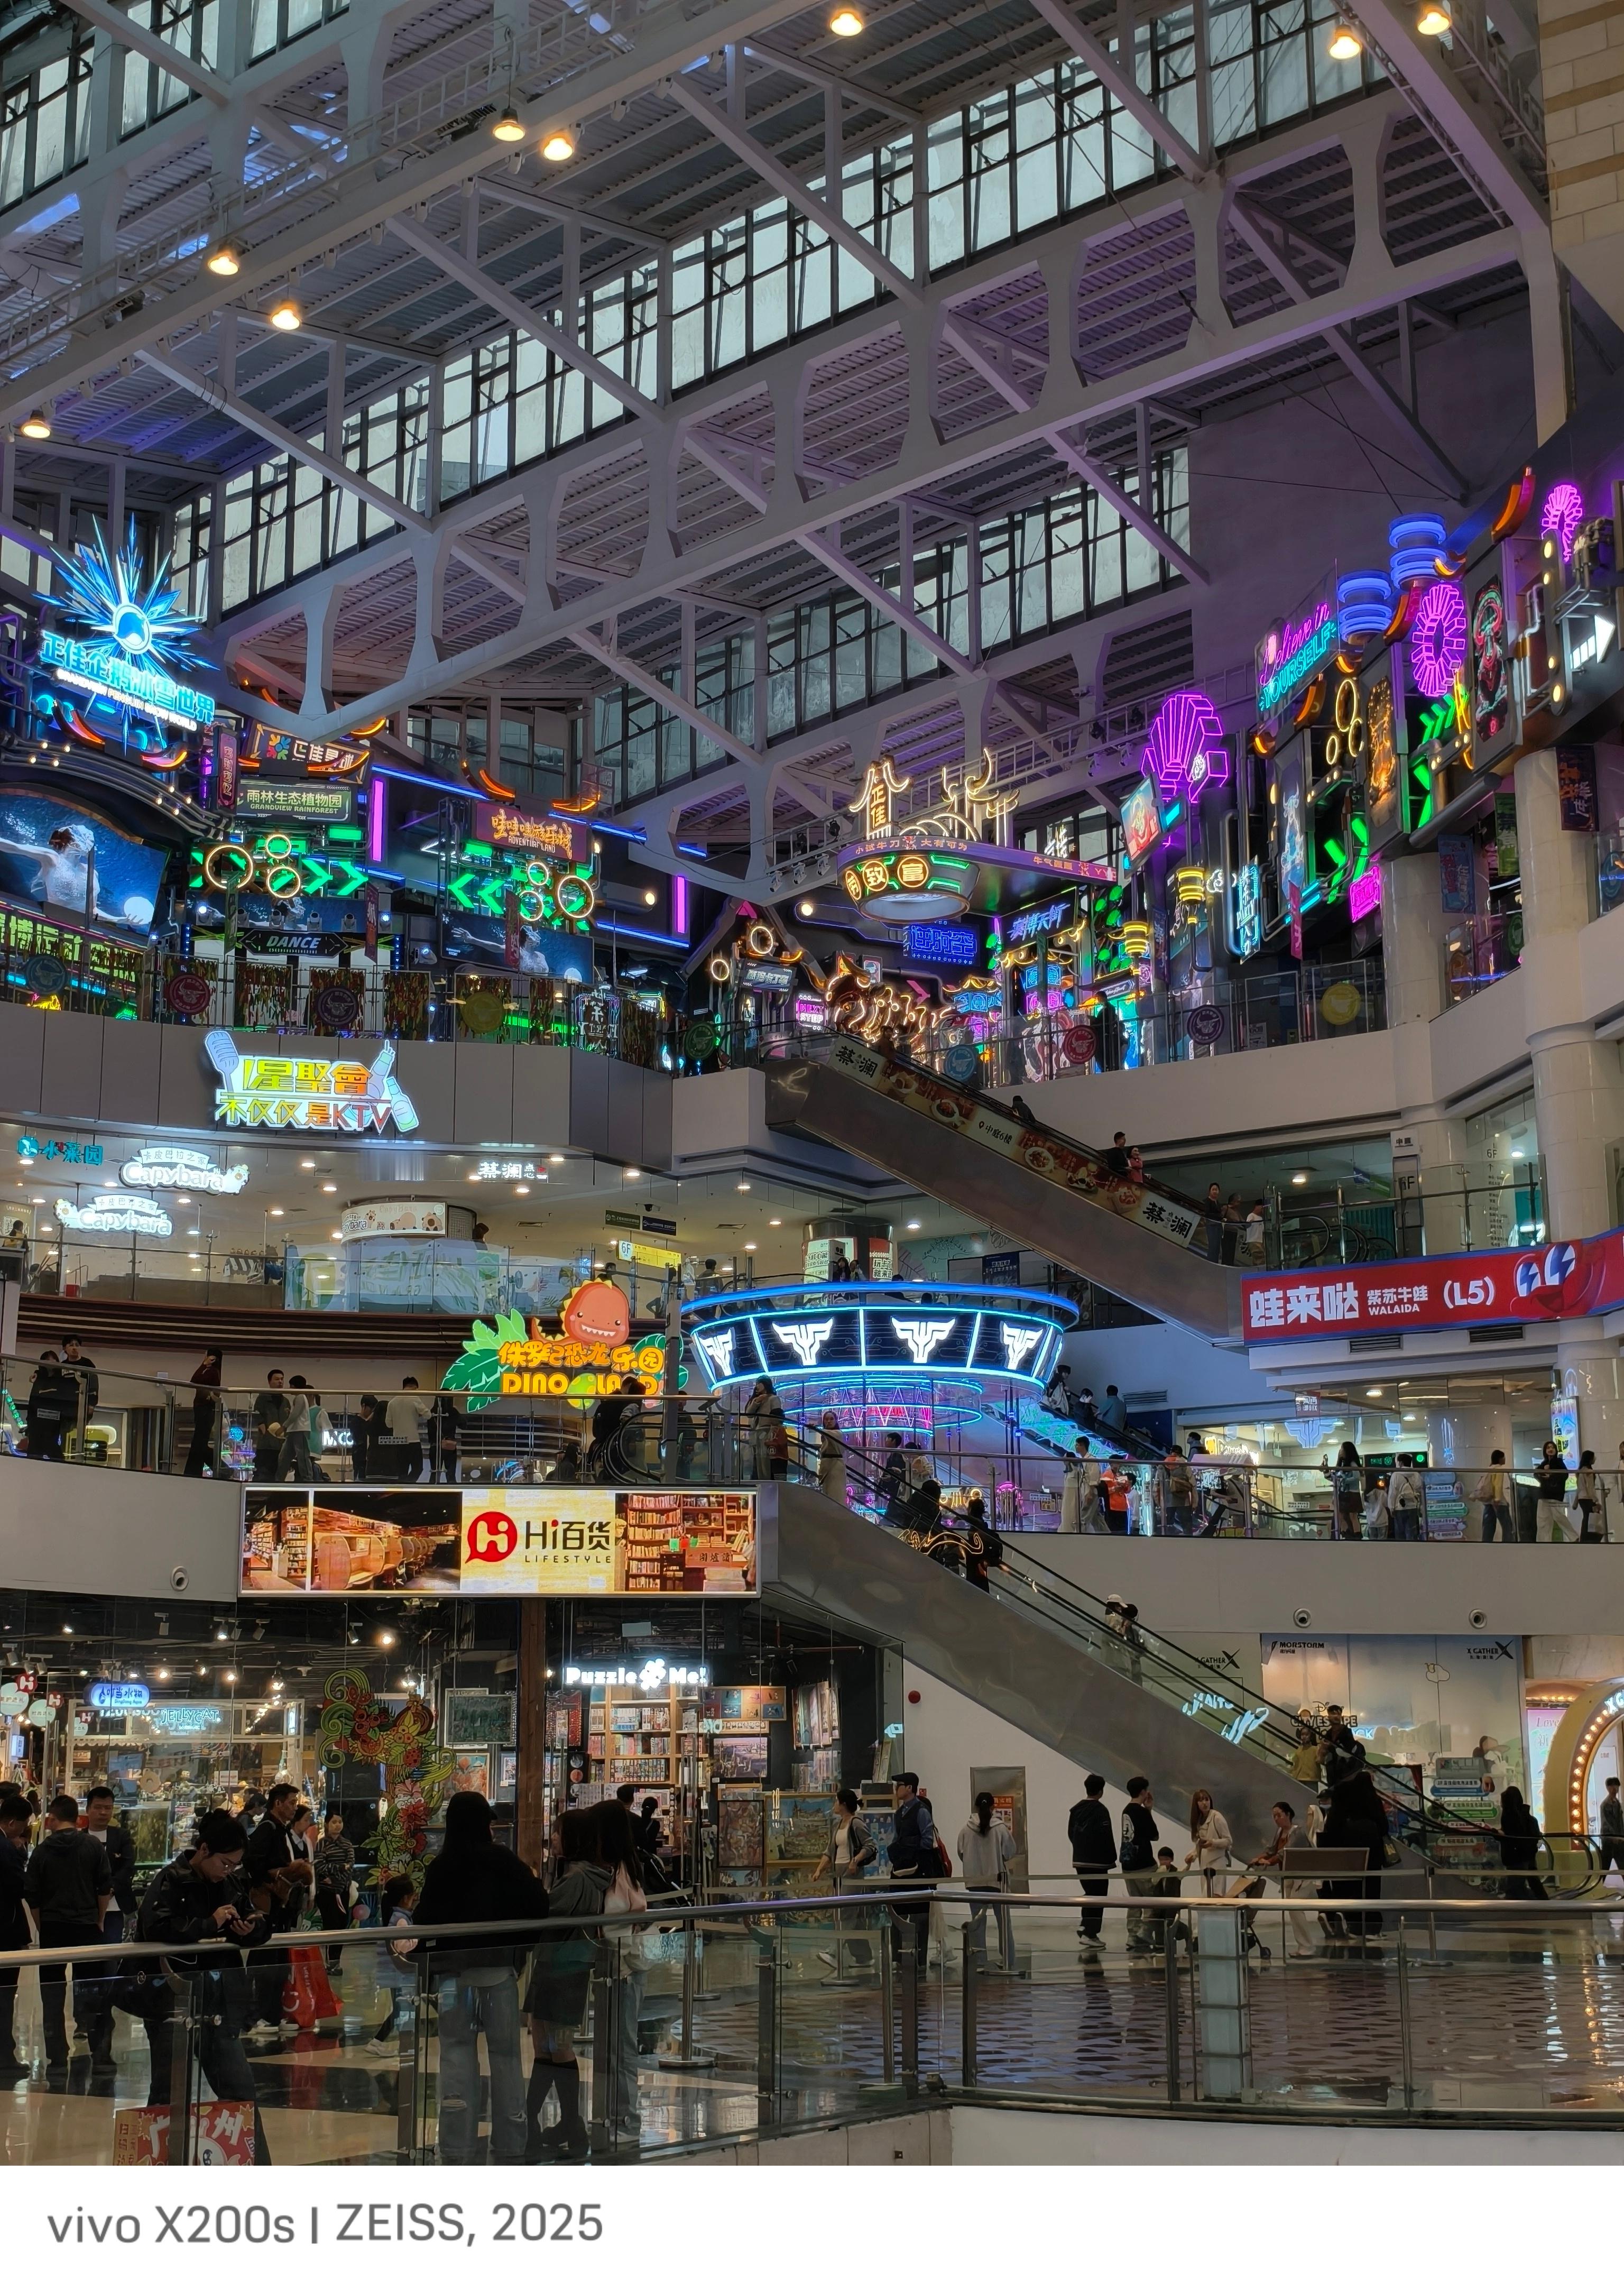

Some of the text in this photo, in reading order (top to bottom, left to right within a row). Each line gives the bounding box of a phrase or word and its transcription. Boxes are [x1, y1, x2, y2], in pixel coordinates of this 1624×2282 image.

[1263, 622, 1331, 708] YOURSELF
[247, 789, 342, 807] 雨林生态植物园
[250, 803, 292, 812] GRANDVIEW
[870, 784, 887, 829] 正佳
[541, 843, 556, 853] LAND
[266, 936, 321, 948] DANCE
[800, 1013, 824, 1023] STEP
[836, 1046, 878, 1078] 蔡澜
[219, 1098, 392, 1135] 不仅仅是KTV
[41, 1140, 104, 1165] 小菜园
[1487, 1149, 1498, 1158] 6F
[125, 1163, 224, 1189] Capybara
[478, 1162, 522, 1179] 蔡澜
[80, 1210, 171, 1235] Capybara
[1143, 1202, 1192, 1239] 蔡澜
[621, 1242, 631, 1254] 6F
[1250, 1282, 1359, 1328] 蛙来哒
[1367, 1285, 1428, 1304] 紫苏牛蛙
[1368, 1304, 1420, 1316] WALAIDA
[499, 1341, 664, 1373] 侏罗纪恐龙乐园
[503, 1373, 658, 1395] DINO LAD
[525, 1519, 612, 1550] Hi百货
[566, 1667, 707, 1685] Puzzle Me!
[1316, 1715, 1358, 1727] ESPE
